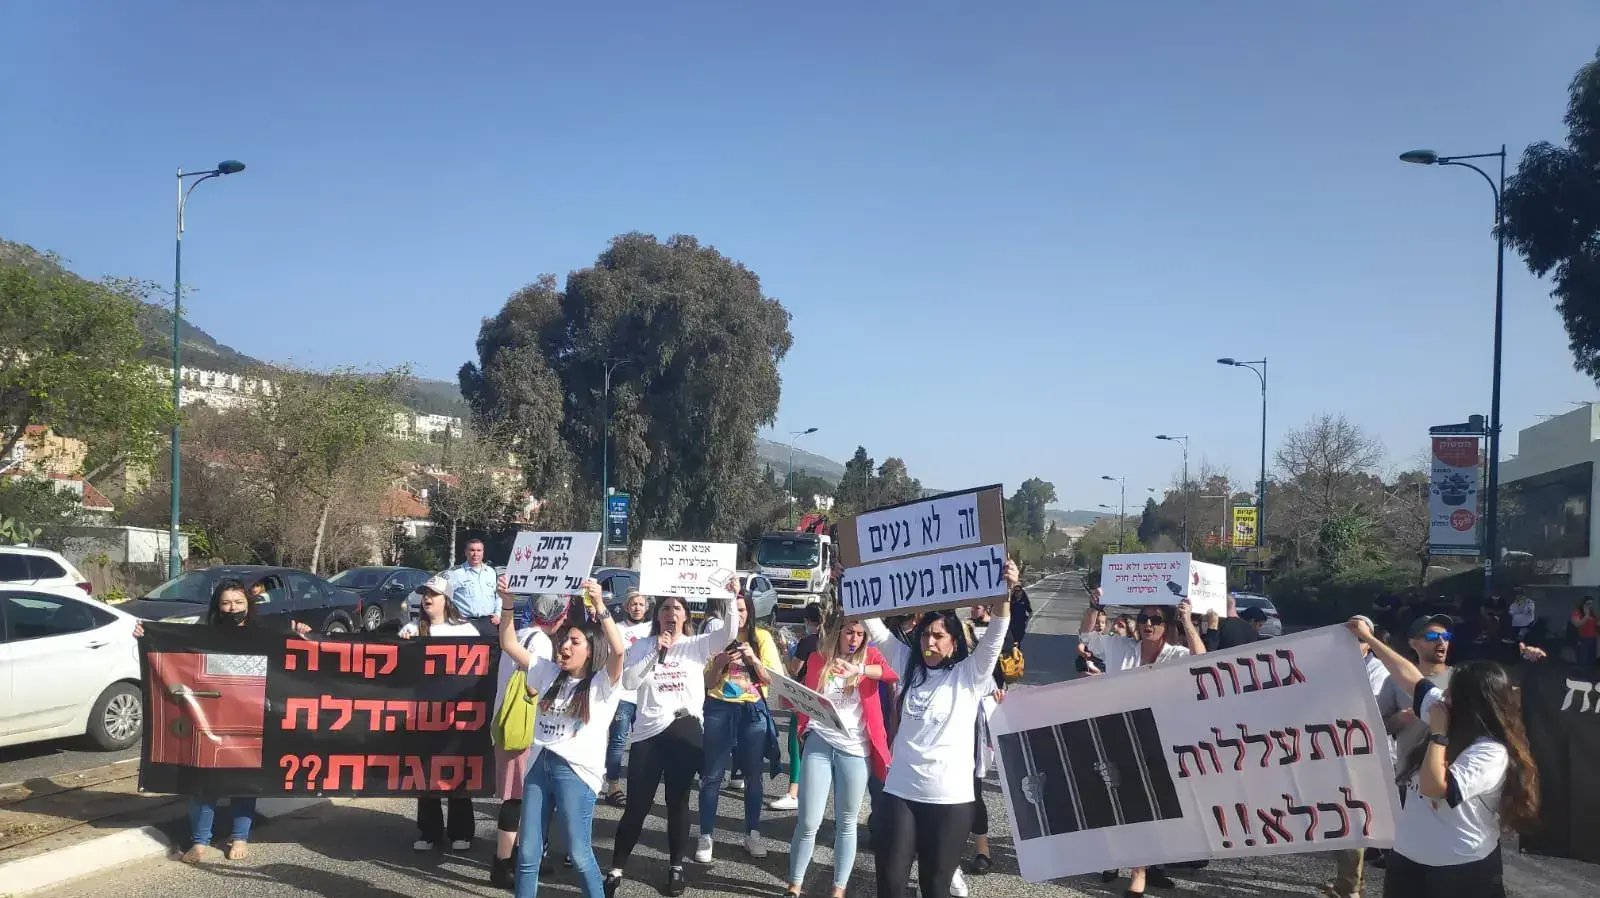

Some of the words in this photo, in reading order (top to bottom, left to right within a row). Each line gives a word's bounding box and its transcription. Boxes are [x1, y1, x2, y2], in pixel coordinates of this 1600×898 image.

[921, 503, 941, 546] לא
[958, 507, 976, 540] זה
[537, 536, 573, 552] החוק
[868, 519, 911, 553] נעים
[668, 543, 687, 552] אבא
[691, 544, 711, 554] אמא
[530, 555, 549, 572] מגן
[552, 552, 569, 570] לא
[659, 556, 674, 567] בגן
[678, 555, 719, 567] המפלצות
[1109, 563, 1123, 571] ננוח
[1126, 562, 1140, 571] ולא
[1143, 562, 1167, 572] נשקוט
[1170, 560, 1181, 570] לא
[678, 571, 698, 581] ולא
[940, 546, 1005, 595] לראות
[1131, 573, 1158, 583] לקבלת
[1162, 574, 1172, 582] עד
[507, 574, 529, 589] הגן
[534, 574, 558, 589] ילדי
[564, 574, 584, 590] על
[1115, 575, 1129, 583] חוק
[843, 576, 882, 609] סגור
[889, 568, 935, 607] מעון
[284, 638, 398, 679] קורה
[424, 644, 490, 676] מה
[1189, 649, 1308, 701] גננות
[281, 694, 486, 731] כשהדלת
[1173, 718, 1374, 778] מתעללות
[279, 754, 484, 790] נסגרת??
[1212, 786, 1374, 849] לכלא!!
